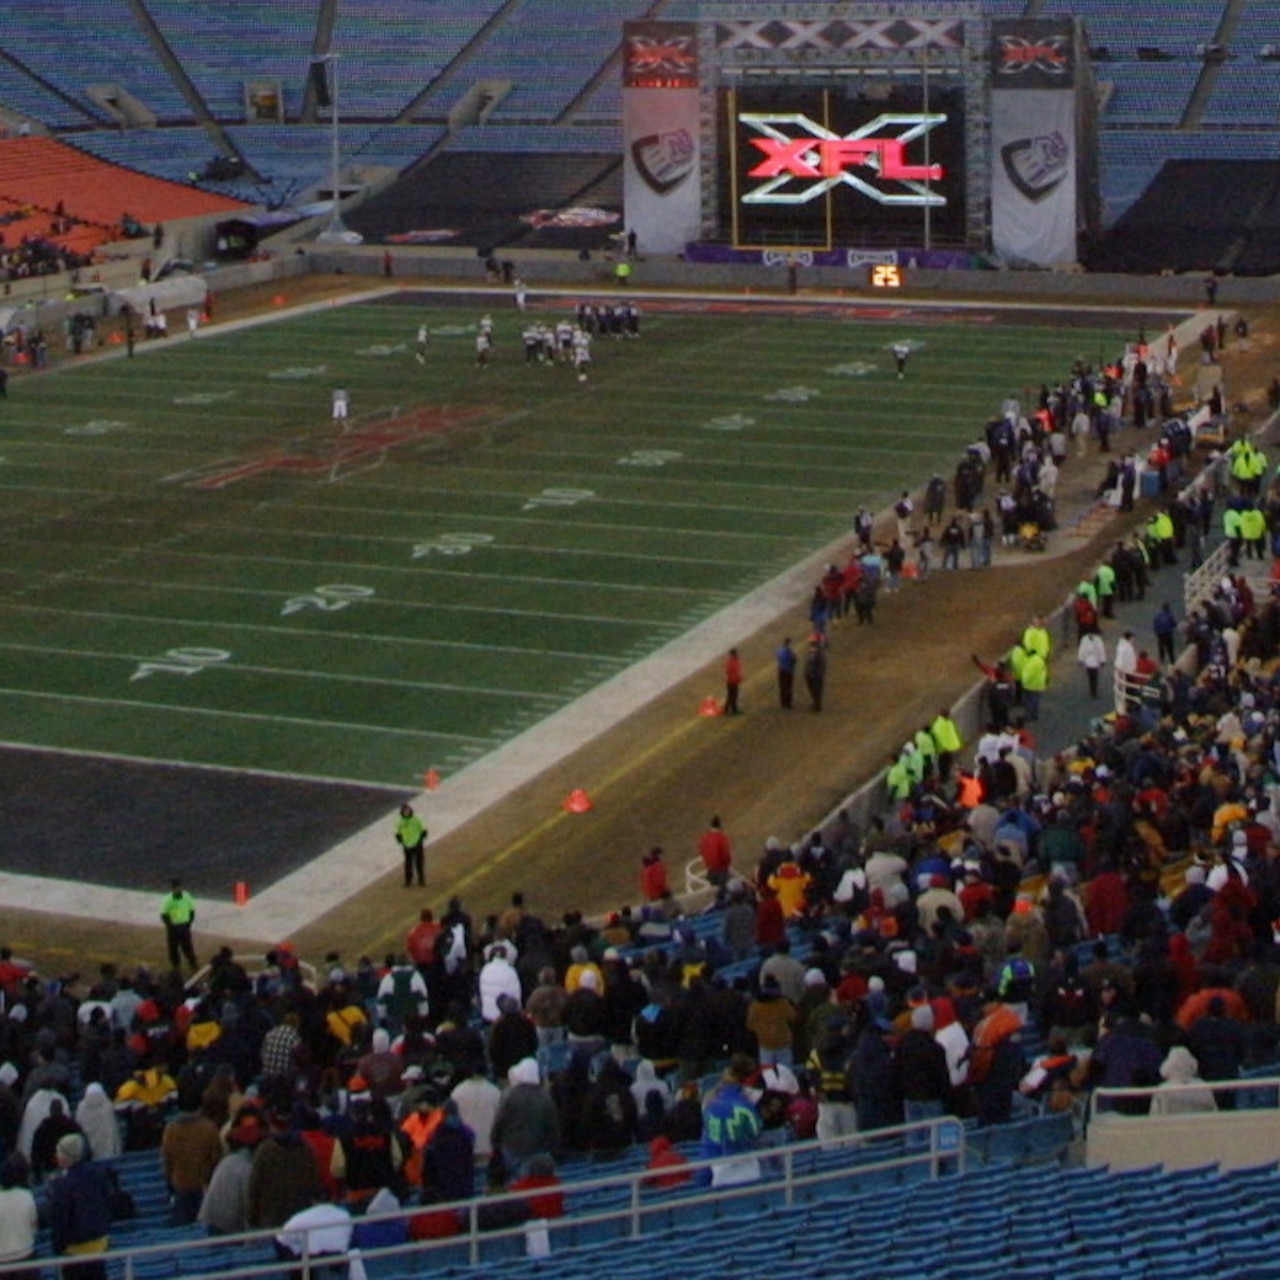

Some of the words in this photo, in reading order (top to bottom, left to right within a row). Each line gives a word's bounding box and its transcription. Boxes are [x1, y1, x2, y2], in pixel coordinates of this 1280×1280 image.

[748, 137, 944, 181] XFL
[872, 266, 899, 286] 25
[279, 583, 375, 616] 20
[129, 646, 231, 681] 10
